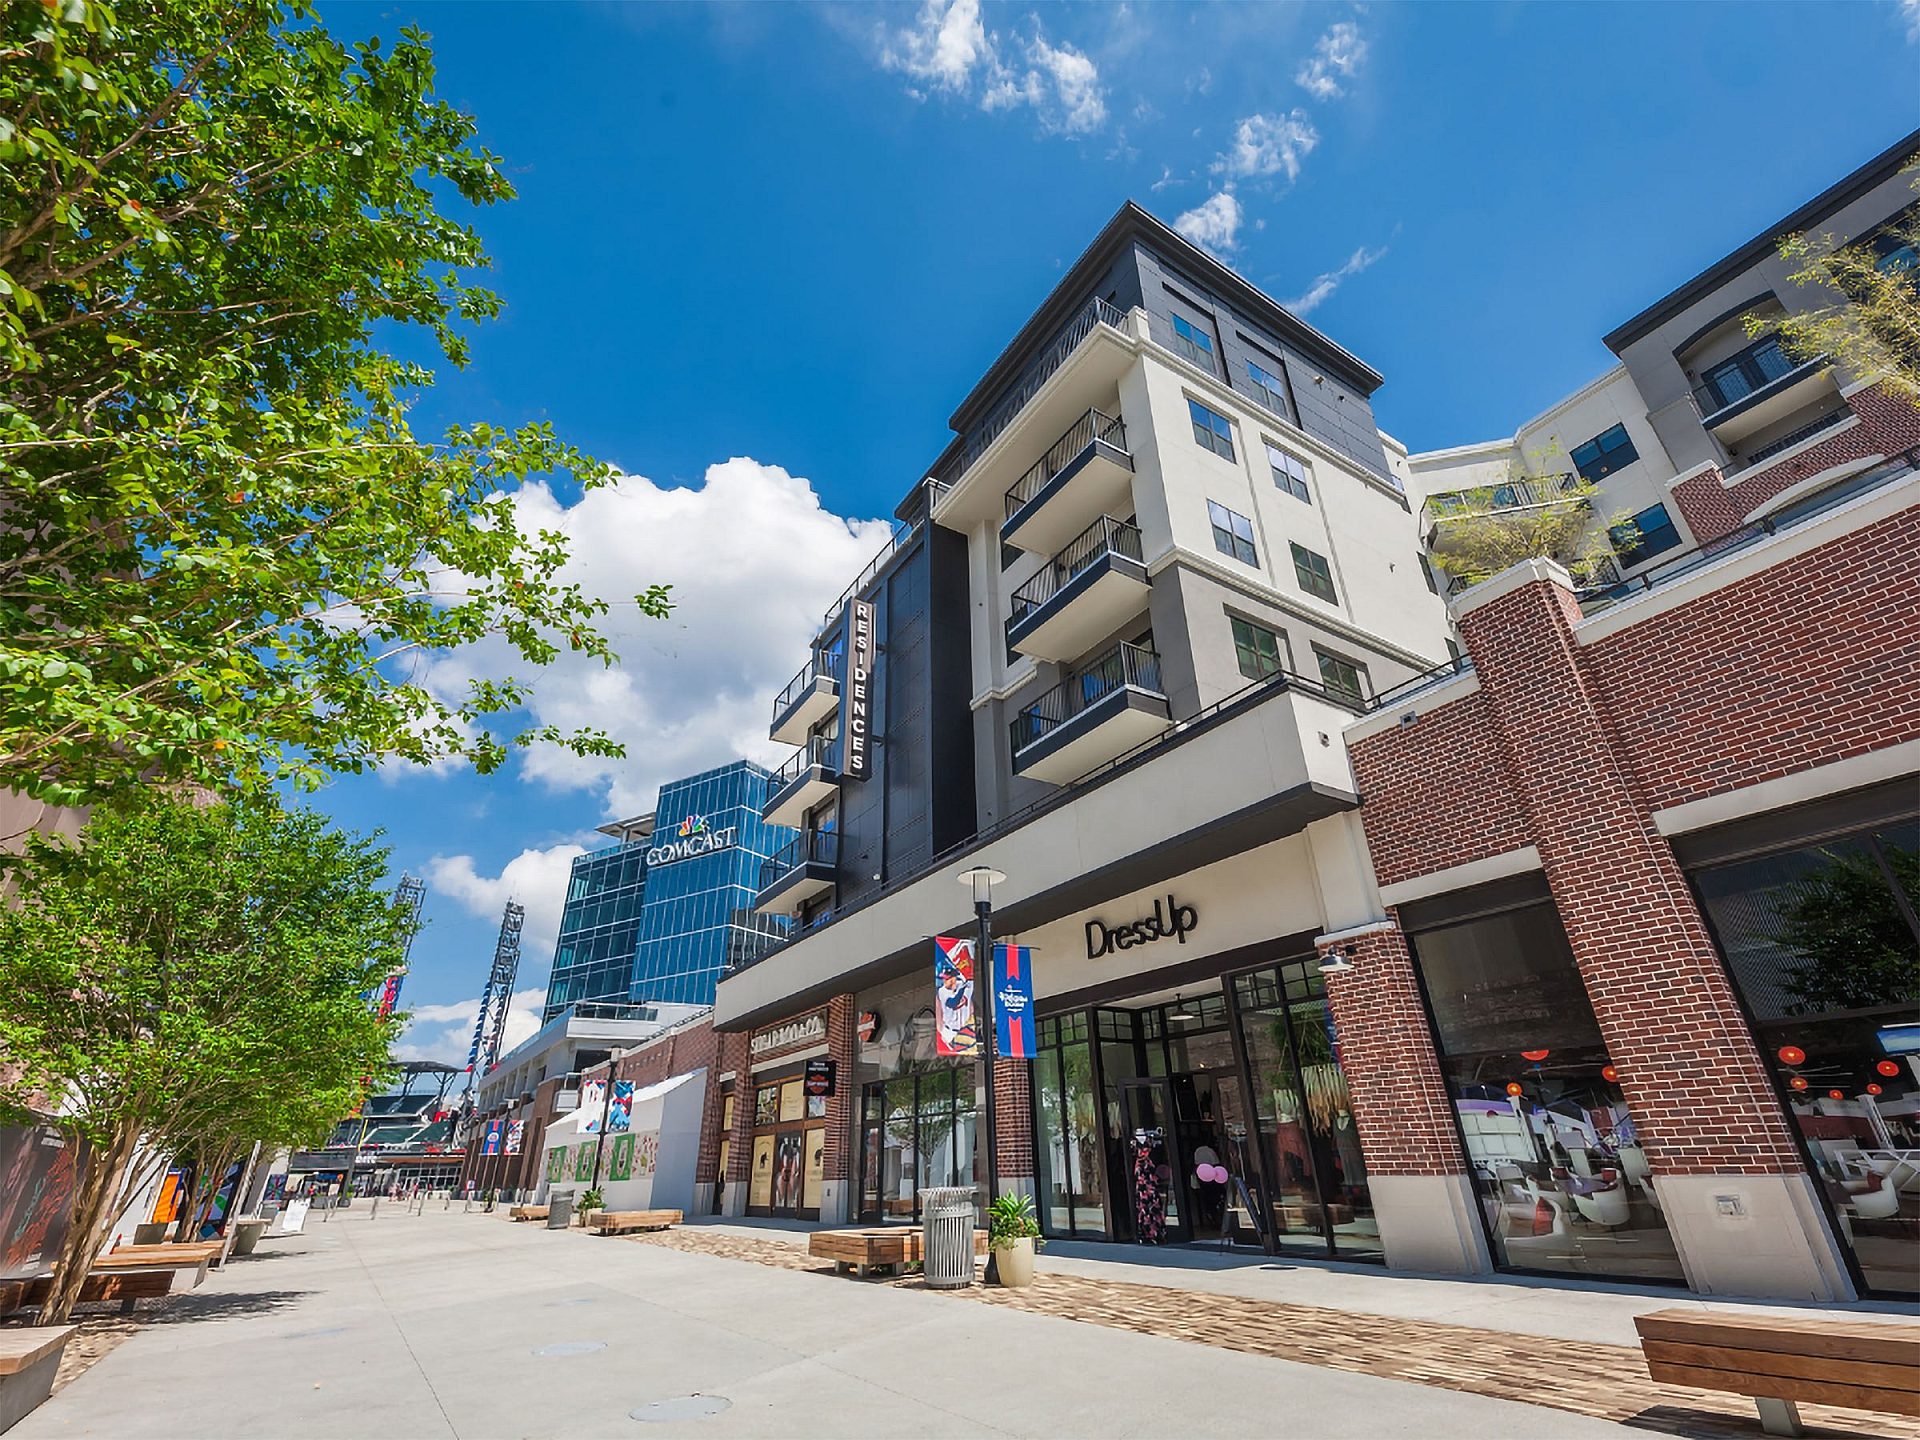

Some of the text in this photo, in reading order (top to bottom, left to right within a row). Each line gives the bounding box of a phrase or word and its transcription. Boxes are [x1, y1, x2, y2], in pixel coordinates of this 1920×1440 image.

[851, 604, 868, 770] RESIDENCES
[646, 826, 737, 866] COMCAST
[1085, 894, 1199, 960] DressUp
